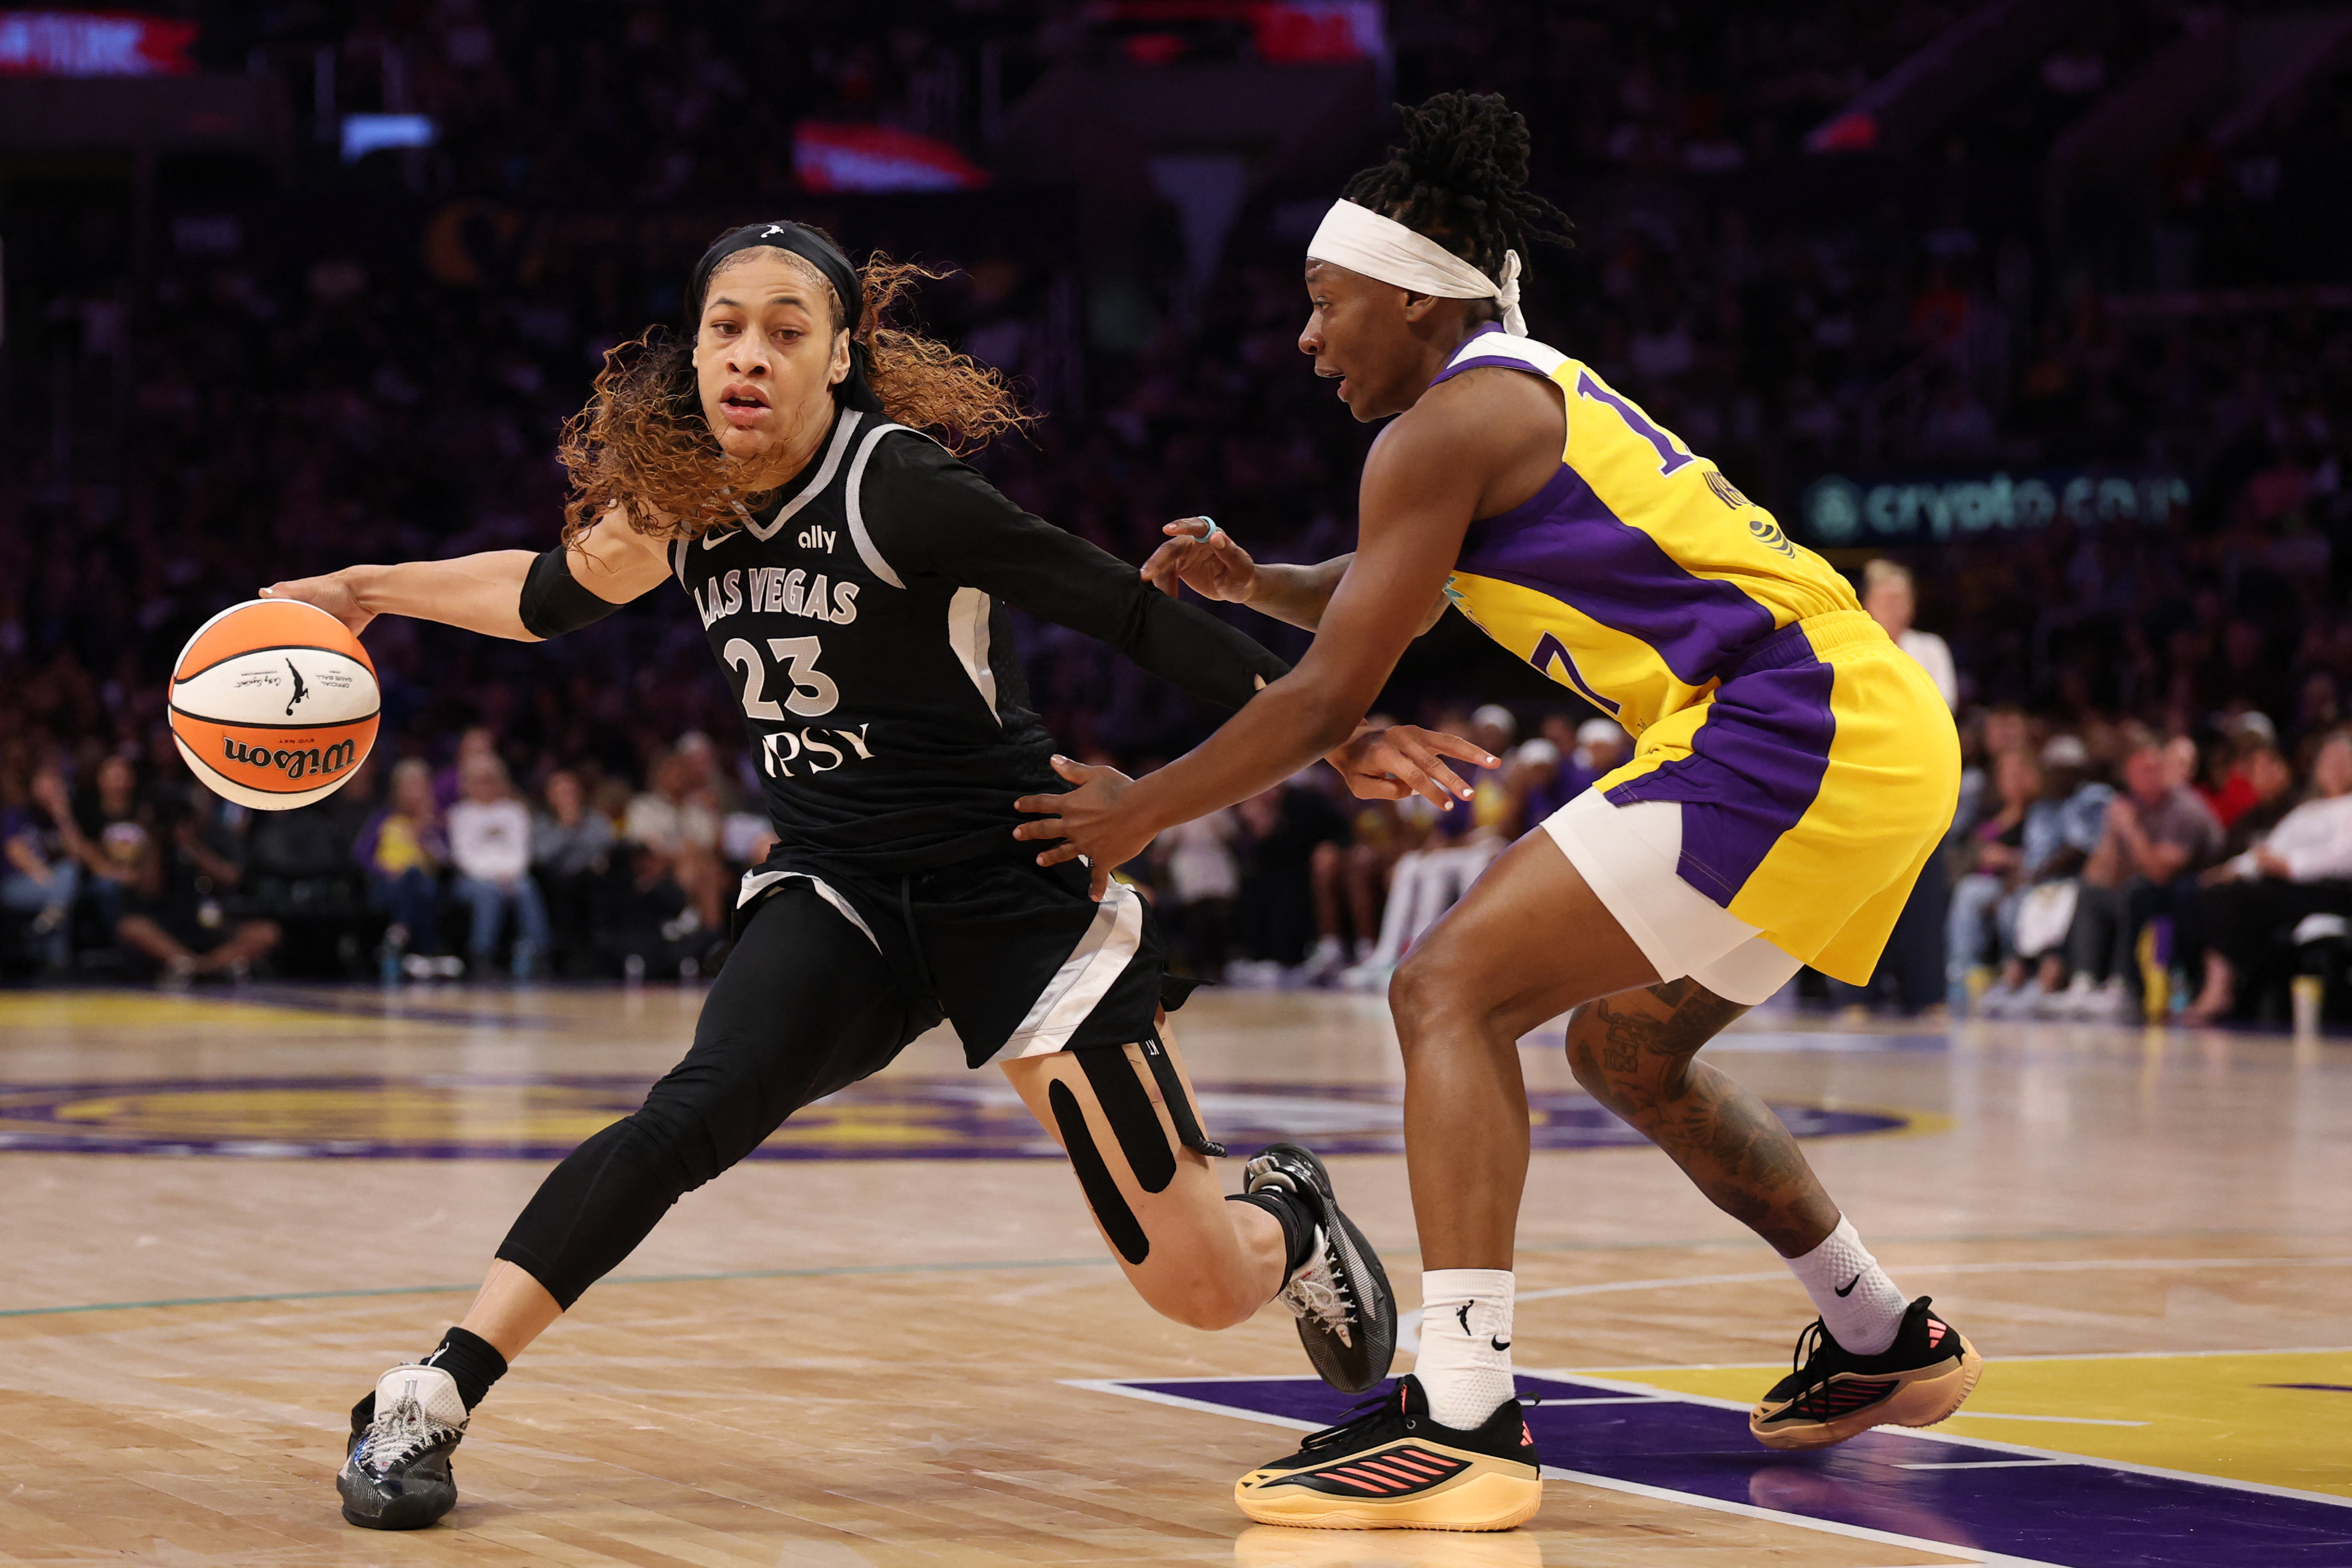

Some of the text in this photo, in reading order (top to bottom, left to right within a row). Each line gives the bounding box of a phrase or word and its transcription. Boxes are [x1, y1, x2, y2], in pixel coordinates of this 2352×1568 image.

[1575, 366, 1698, 479] 1
[798, 525, 837, 554] ally
[694, 567, 860, 632] LAS VEGAS
[723, 635, 839, 721] 23
[223, 737, 355, 779] Wilson
[1145, 1038, 1160, 1055] KT
